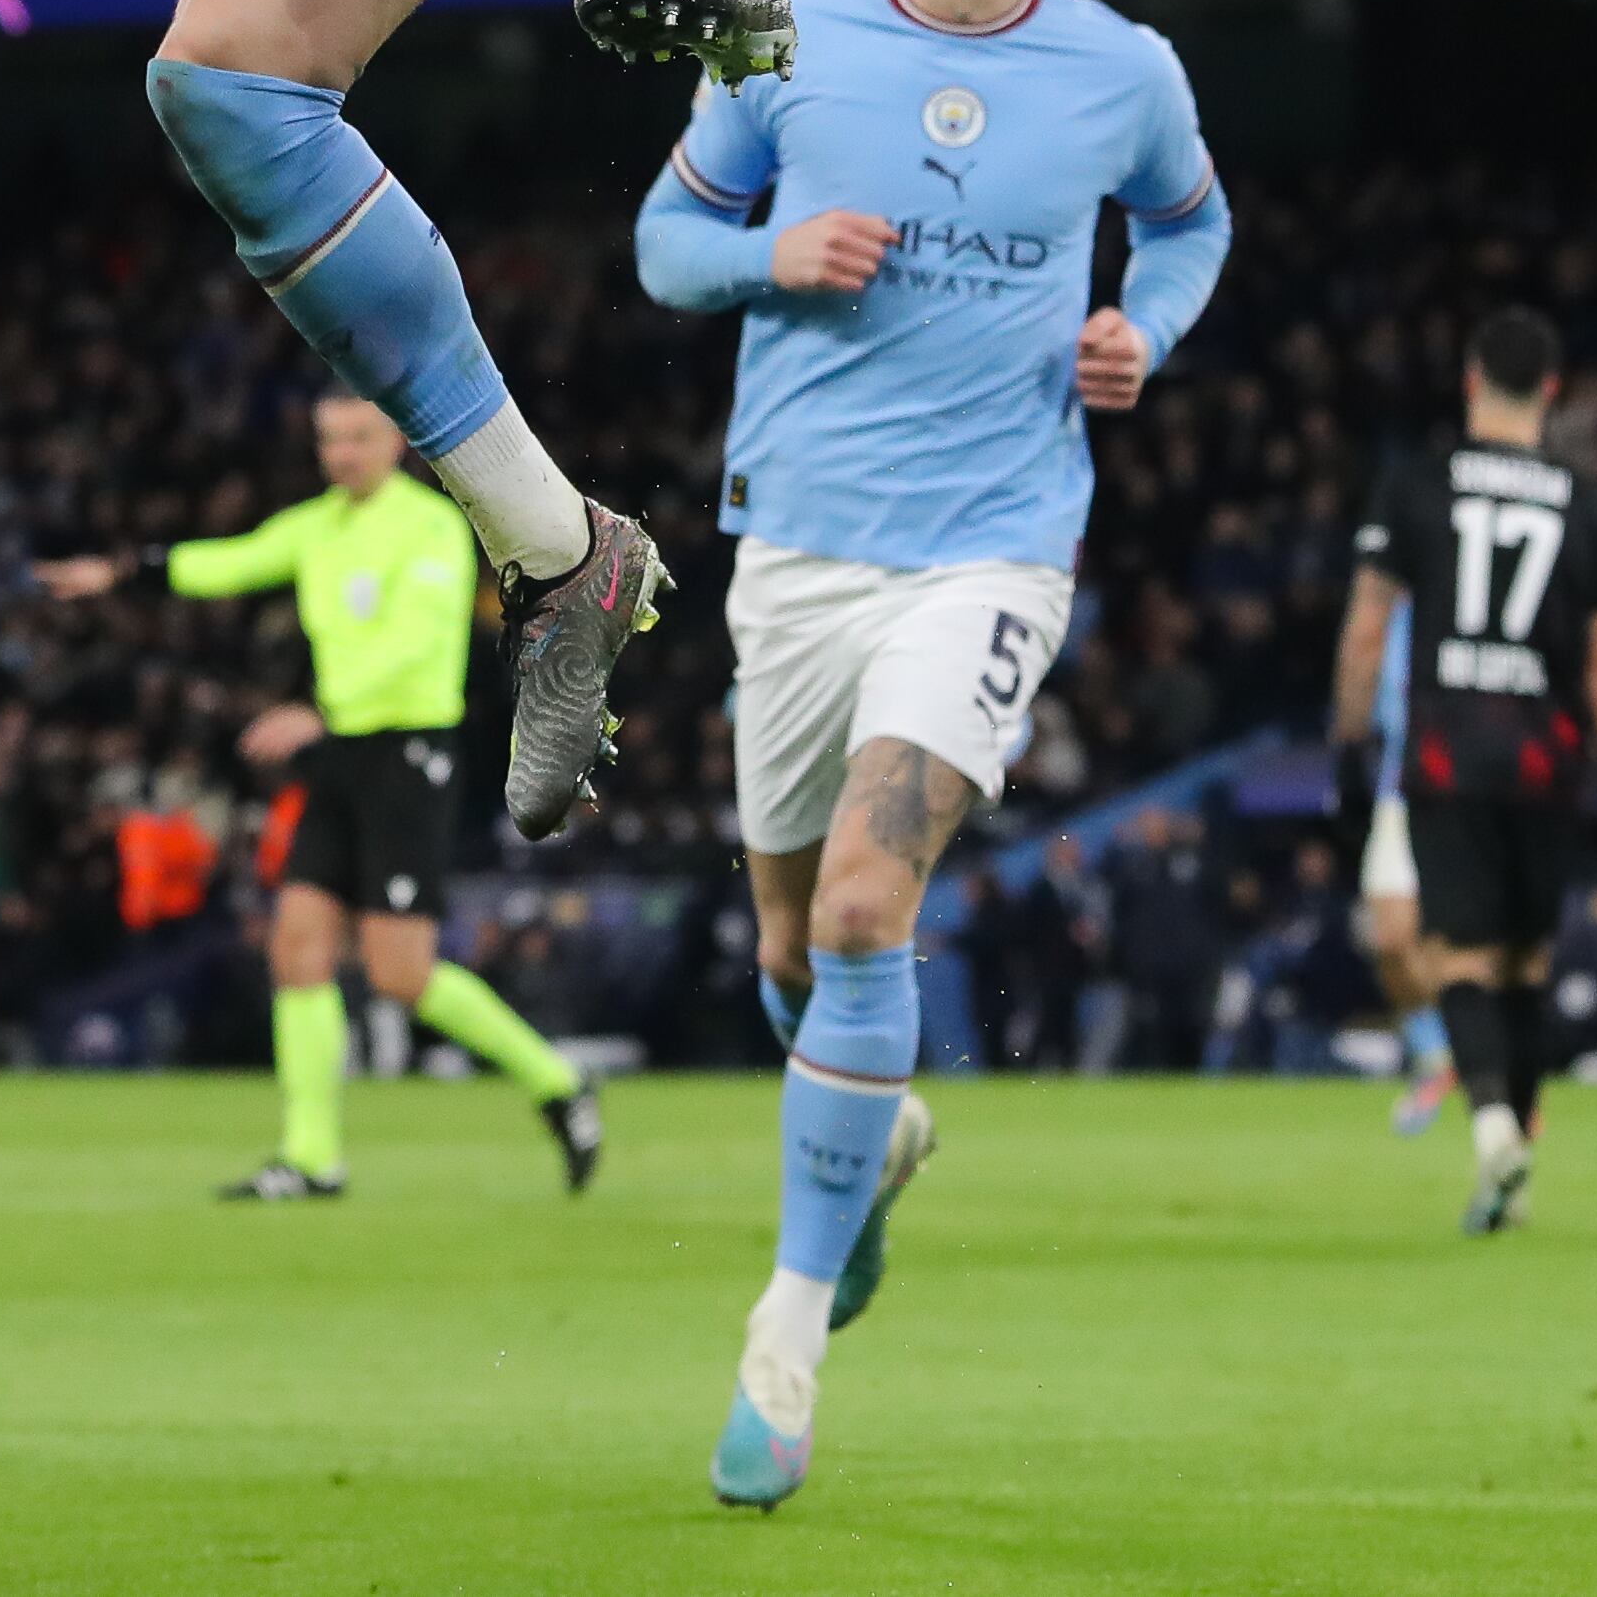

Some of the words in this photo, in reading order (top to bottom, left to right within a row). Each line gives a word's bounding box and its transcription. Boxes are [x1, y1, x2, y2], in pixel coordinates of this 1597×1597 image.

[885, 218, 1047, 269] IHAD
[1451, 497, 1564, 643] 17
[981, 609, 1028, 707] 5
